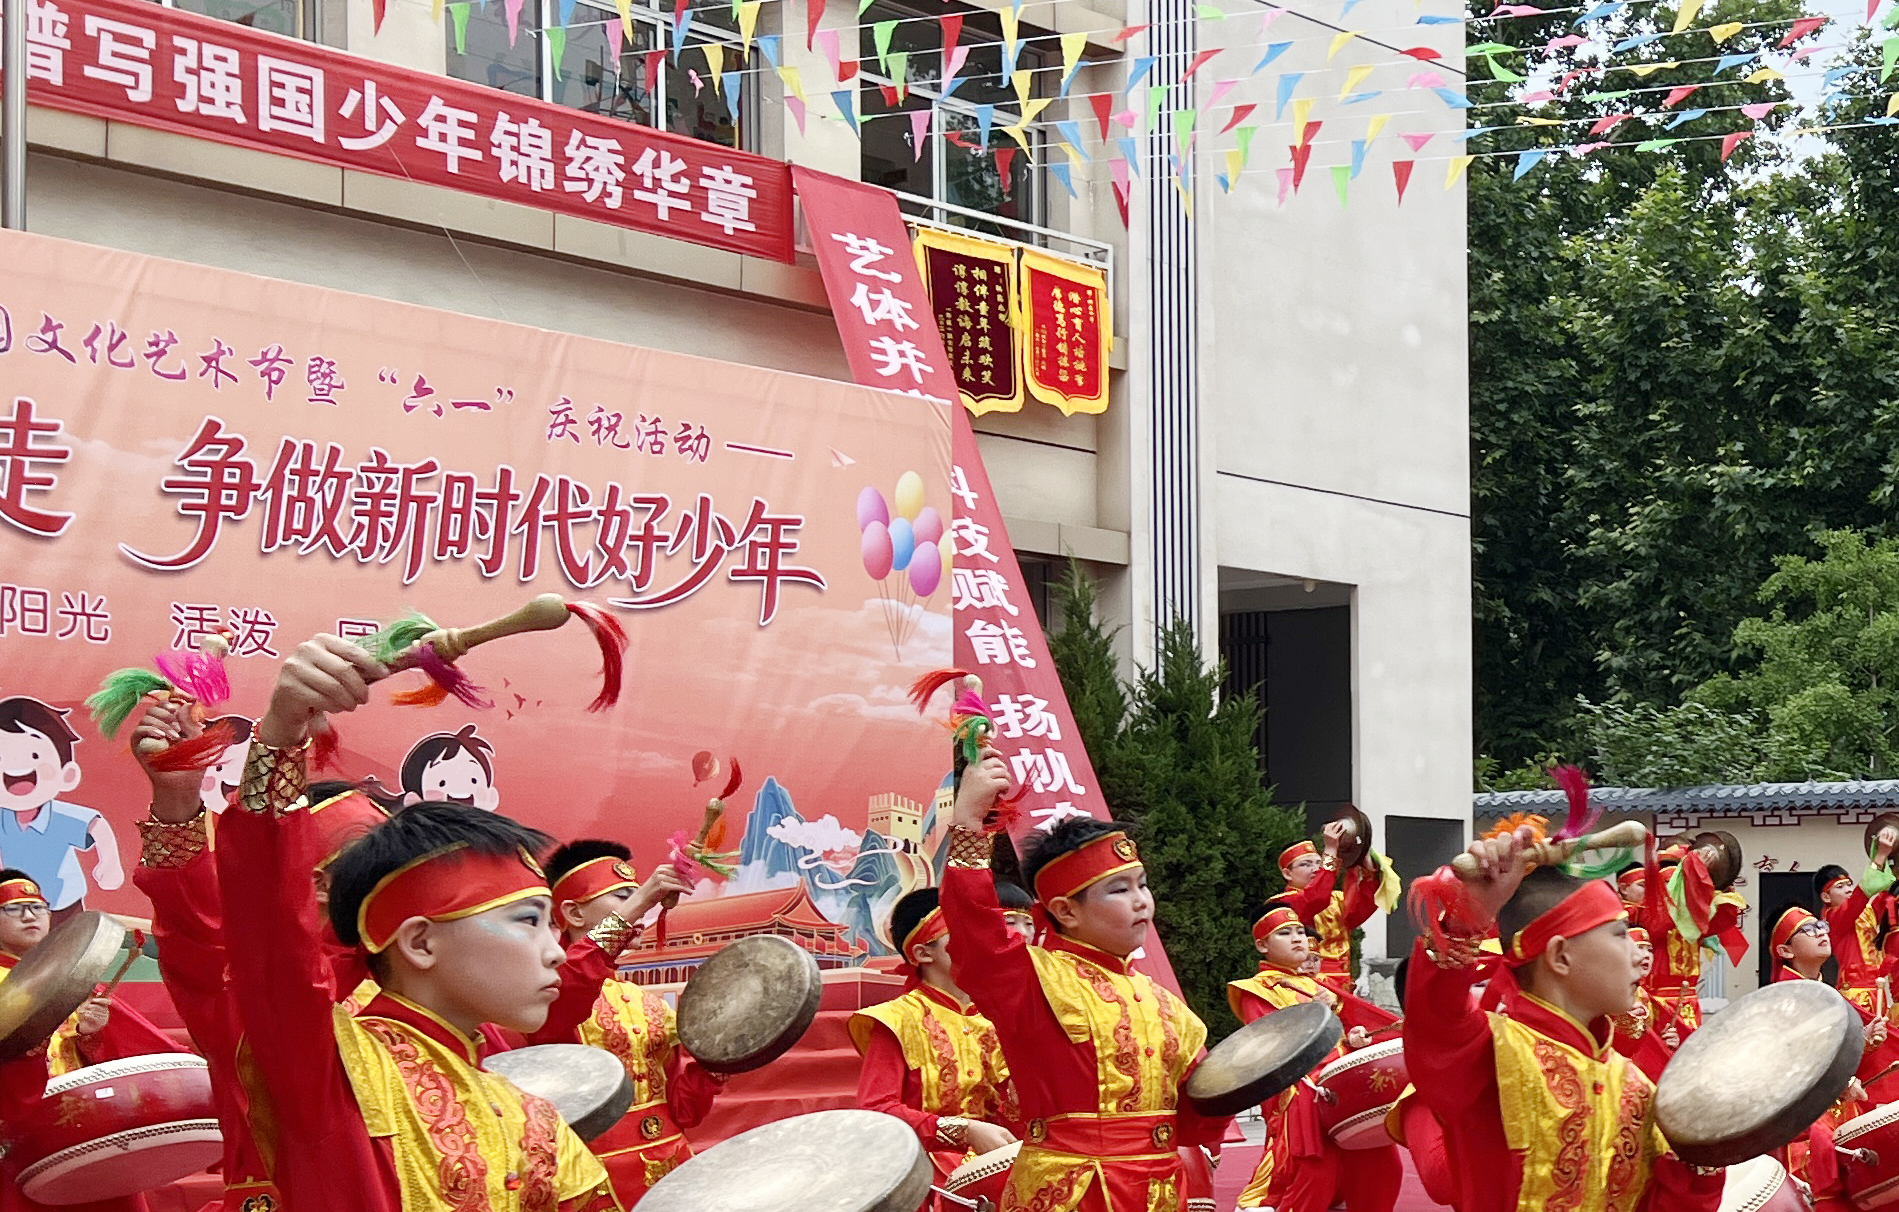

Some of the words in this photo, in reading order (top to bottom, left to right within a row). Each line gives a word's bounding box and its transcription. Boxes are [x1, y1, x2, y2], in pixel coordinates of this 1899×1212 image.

[0, 399, 74, 535] 走
[119, 417, 827, 627] 争做新时代好少年
[0, 587, 109, 641] 阳光
[172, 603, 278, 656] 活泼
